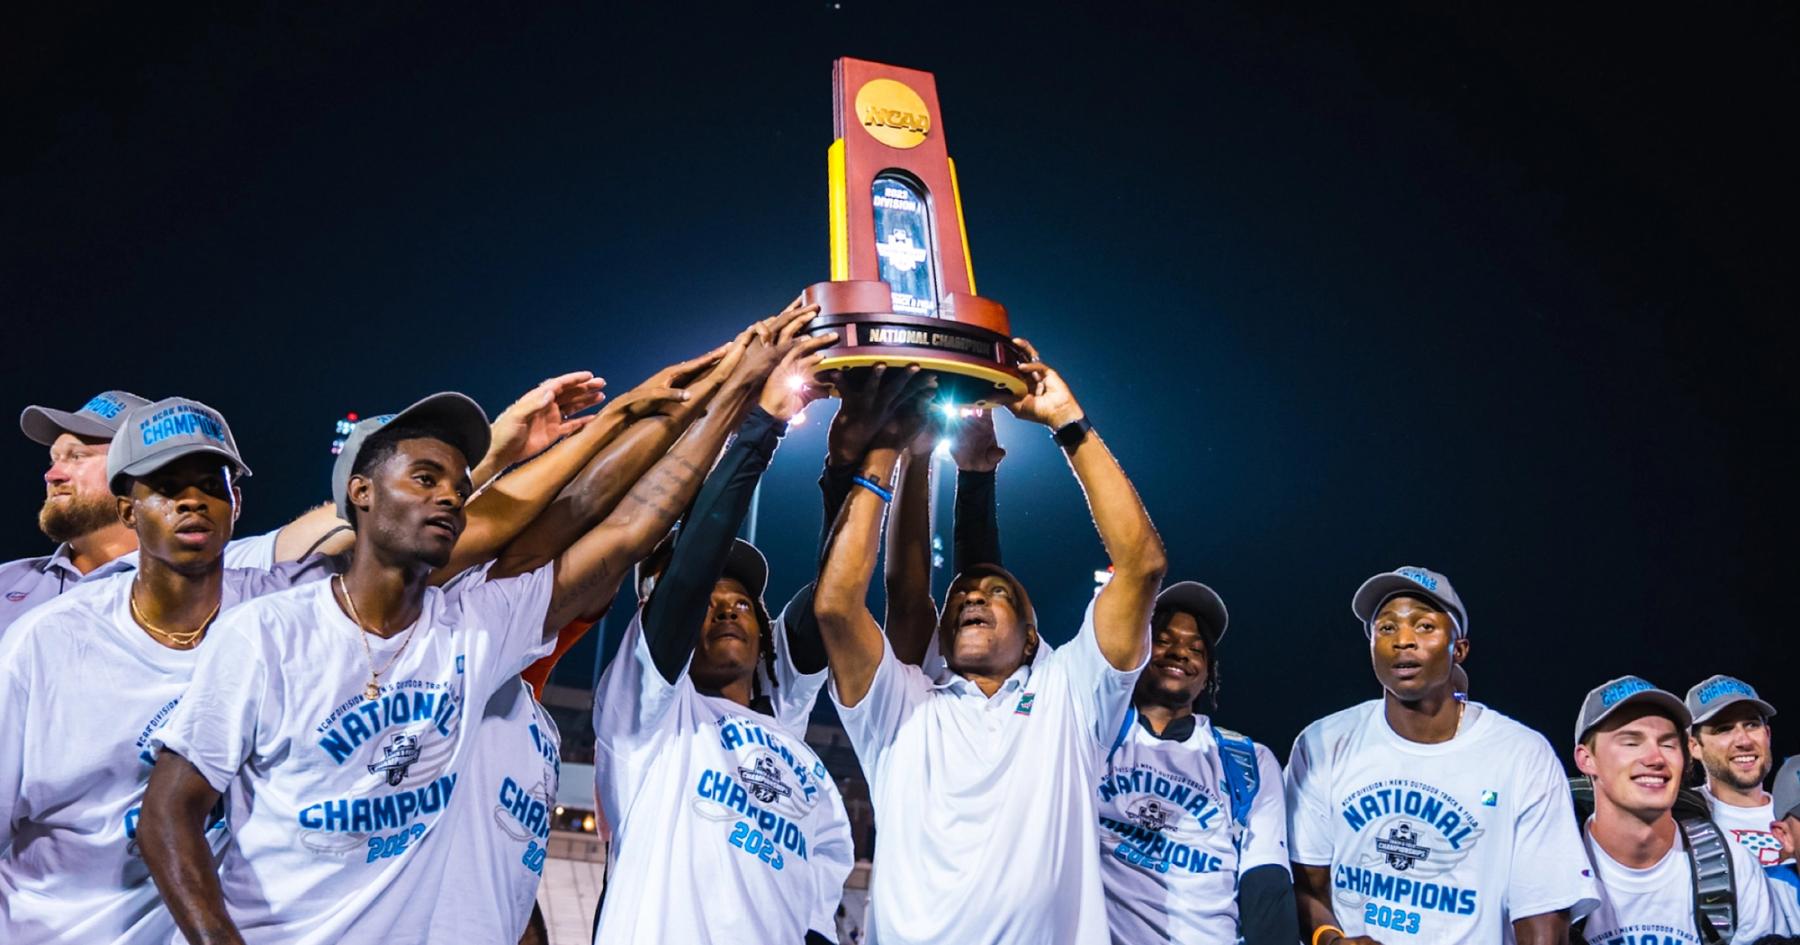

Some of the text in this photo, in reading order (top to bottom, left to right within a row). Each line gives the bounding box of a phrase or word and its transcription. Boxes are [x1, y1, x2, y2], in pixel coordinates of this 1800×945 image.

[865, 106, 930, 135] NCAA
[874, 195, 916, 211] DIVISION
[869, 328, 930, 345] NATIONAL
[150, 699, 179, 727] DIVISION
[335, 694, 364, 717] DIVISION
[1099, 770, 1219, 830] NATIONAL
[1356, 781, 1383, 797] DIVISION
[1389, 779, 1408, 787] MEN'S
[1410, 780, 1439, 794] OUTDOOR
[1441, 791, 1458, 807] TRACK
[1463, 811, 1479, 828] FIELD
[1342, 788, 1472, 850] NATIONAL
[728, 821, 784, 870] 2023
[1334, 864, 1477, 915] CHAMPIONS
[1364, 902, 1421, 934] 2023
[1642, 923, 1674, 933] OUTDOOR
